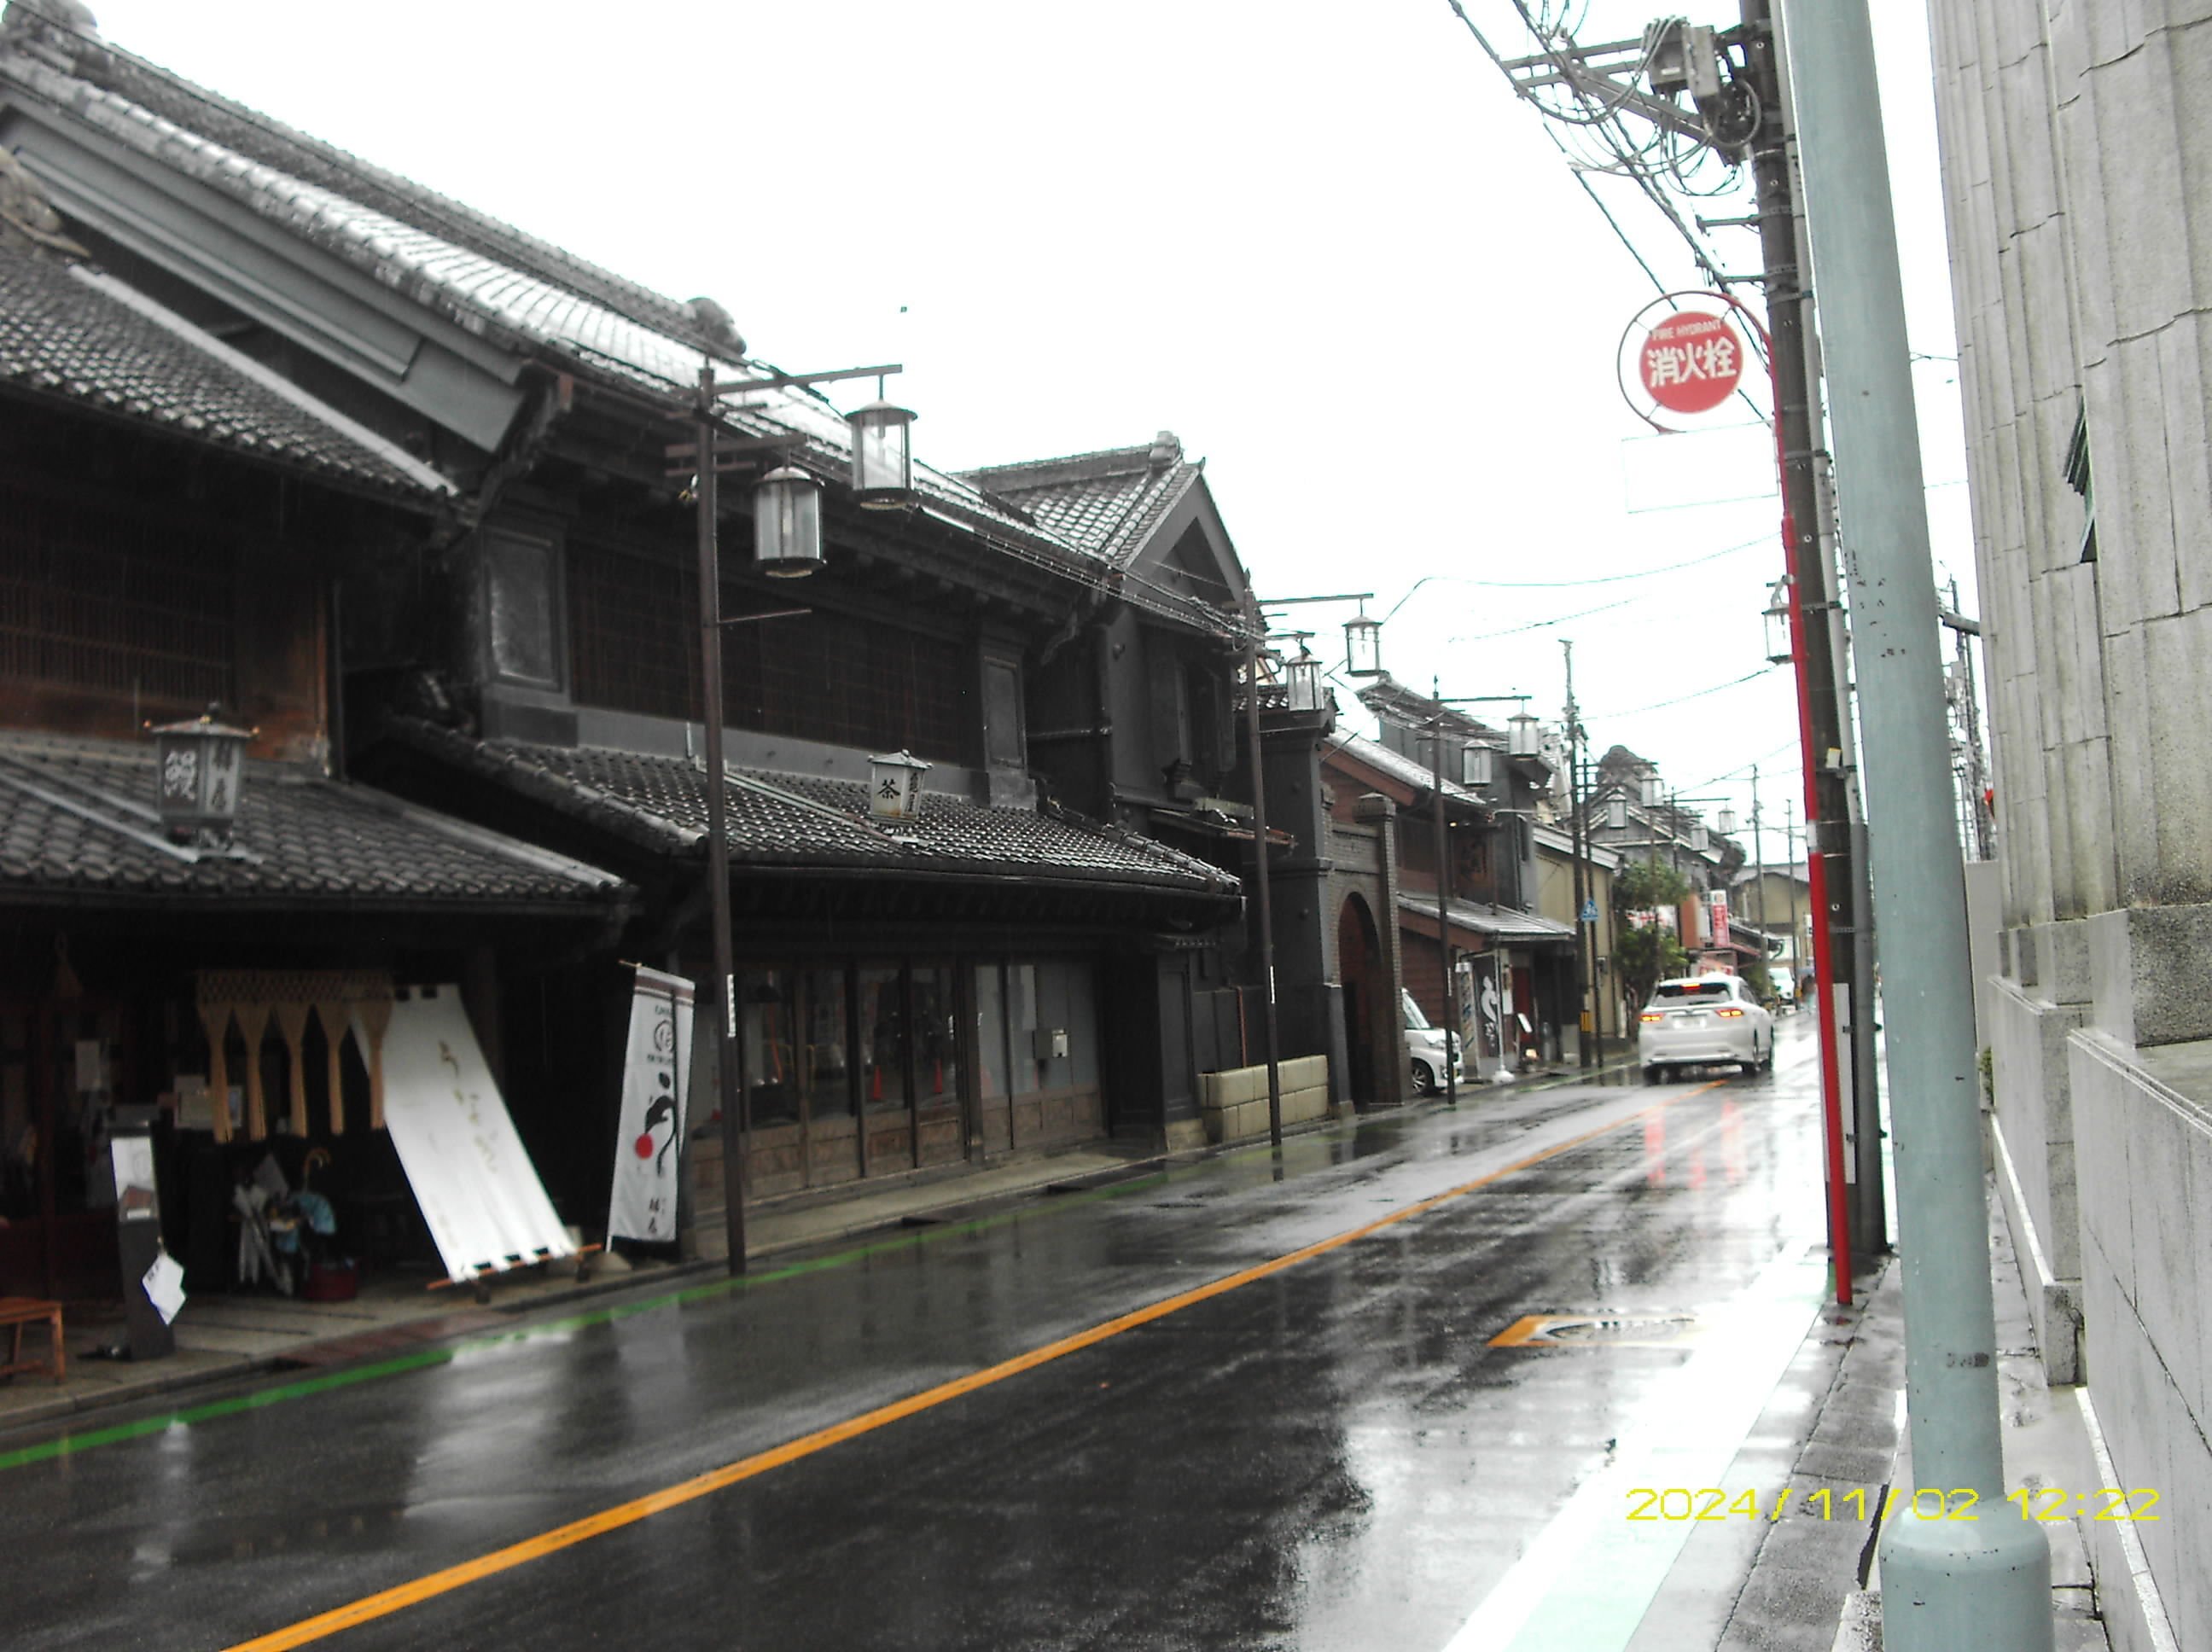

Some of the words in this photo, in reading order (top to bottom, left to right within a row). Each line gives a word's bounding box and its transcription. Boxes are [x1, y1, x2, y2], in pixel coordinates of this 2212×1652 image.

[1647, 336, 1737, 387] 消火栓
[877, 778, 901, 799] 茶
